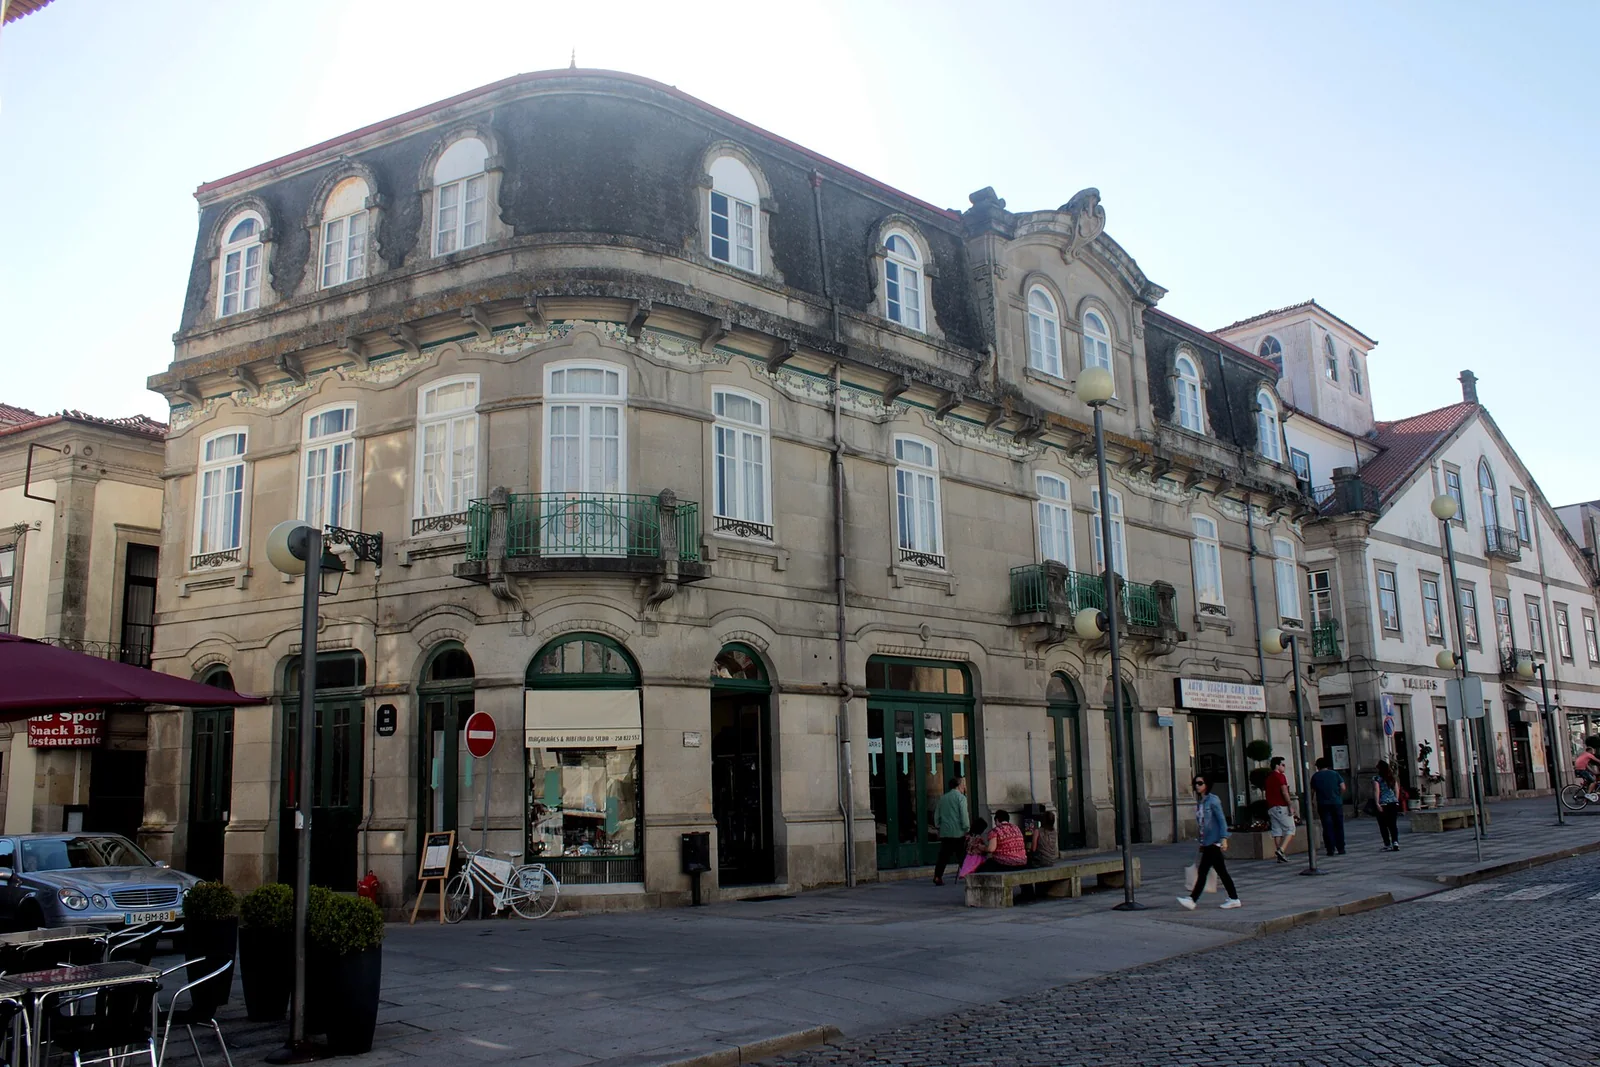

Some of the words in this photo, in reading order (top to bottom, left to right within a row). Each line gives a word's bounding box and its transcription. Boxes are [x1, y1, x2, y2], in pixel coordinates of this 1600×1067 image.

[31, 725, 69, 736] Snack
[74, 725, 98, 735] Bar
[28, 735, 102, 746] Restaurante
